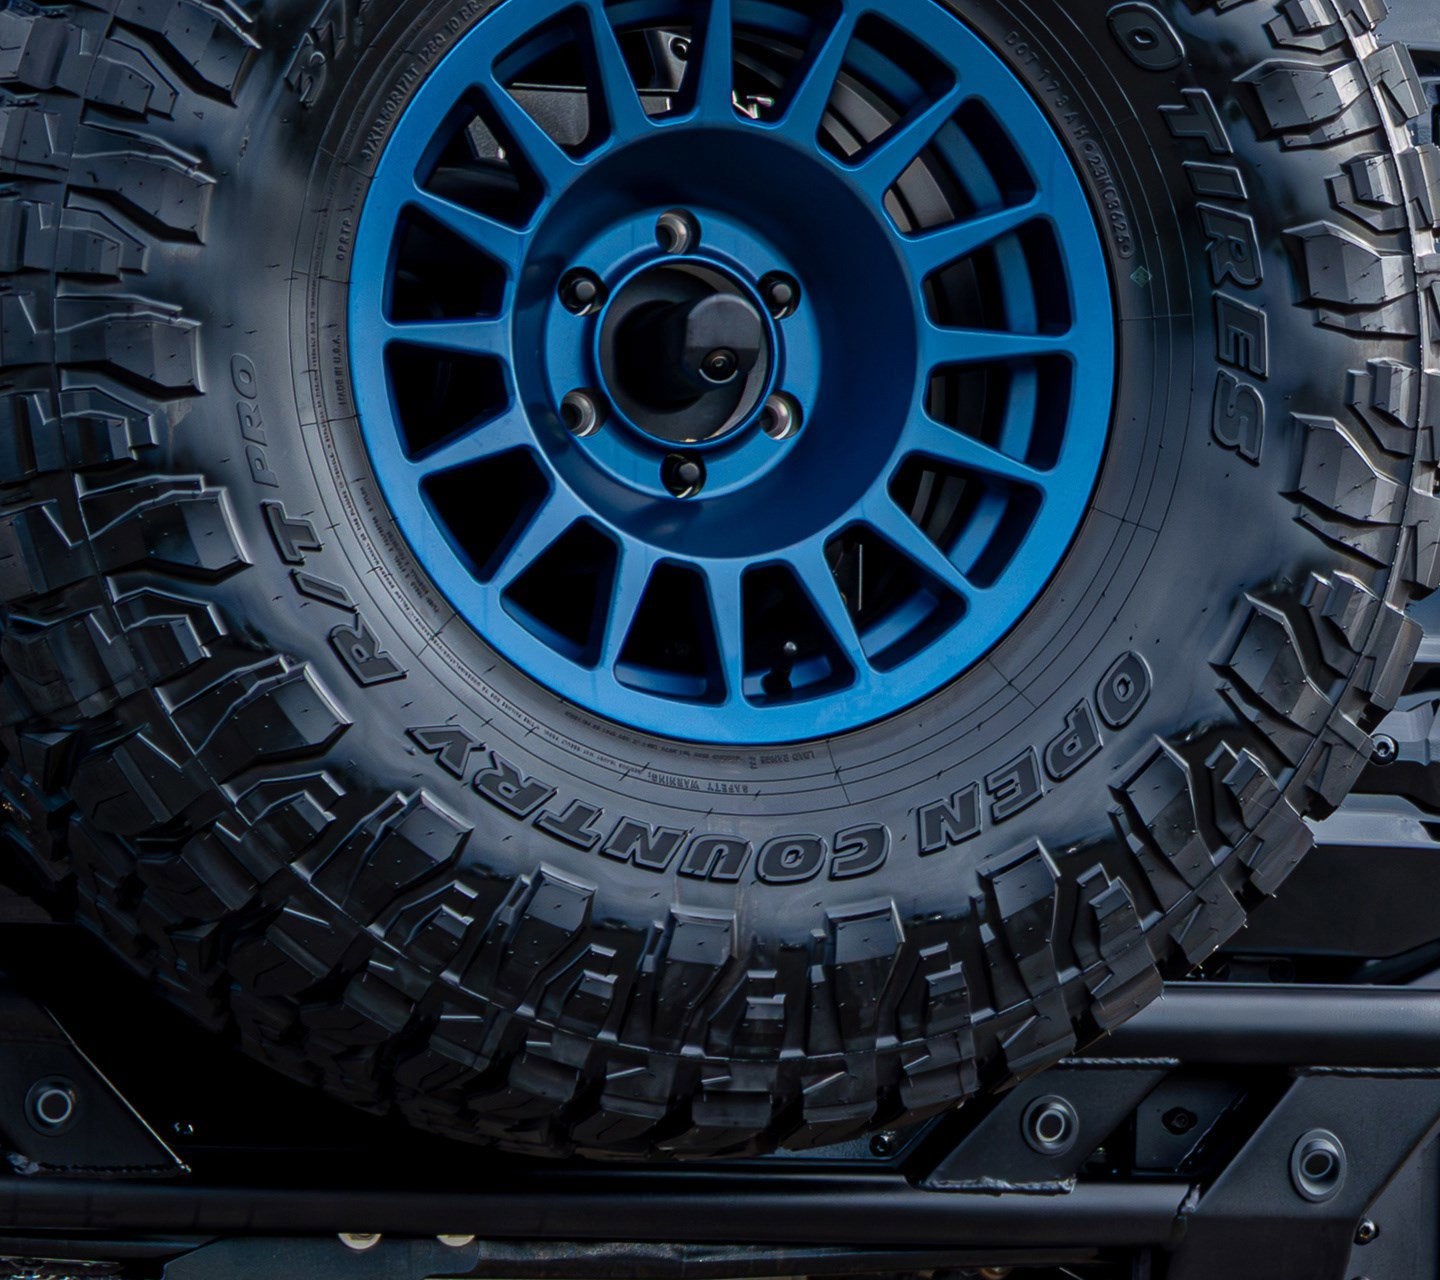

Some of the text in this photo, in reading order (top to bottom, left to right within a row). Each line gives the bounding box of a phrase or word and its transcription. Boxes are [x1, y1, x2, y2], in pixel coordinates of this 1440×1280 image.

[1156, 86, 1268, 467] TIRES
[230, 351, 281, 488] PRO
[259, 500, 410, 688] R/T
[404, 651, 1153, 885] OPEN COUNTRY
